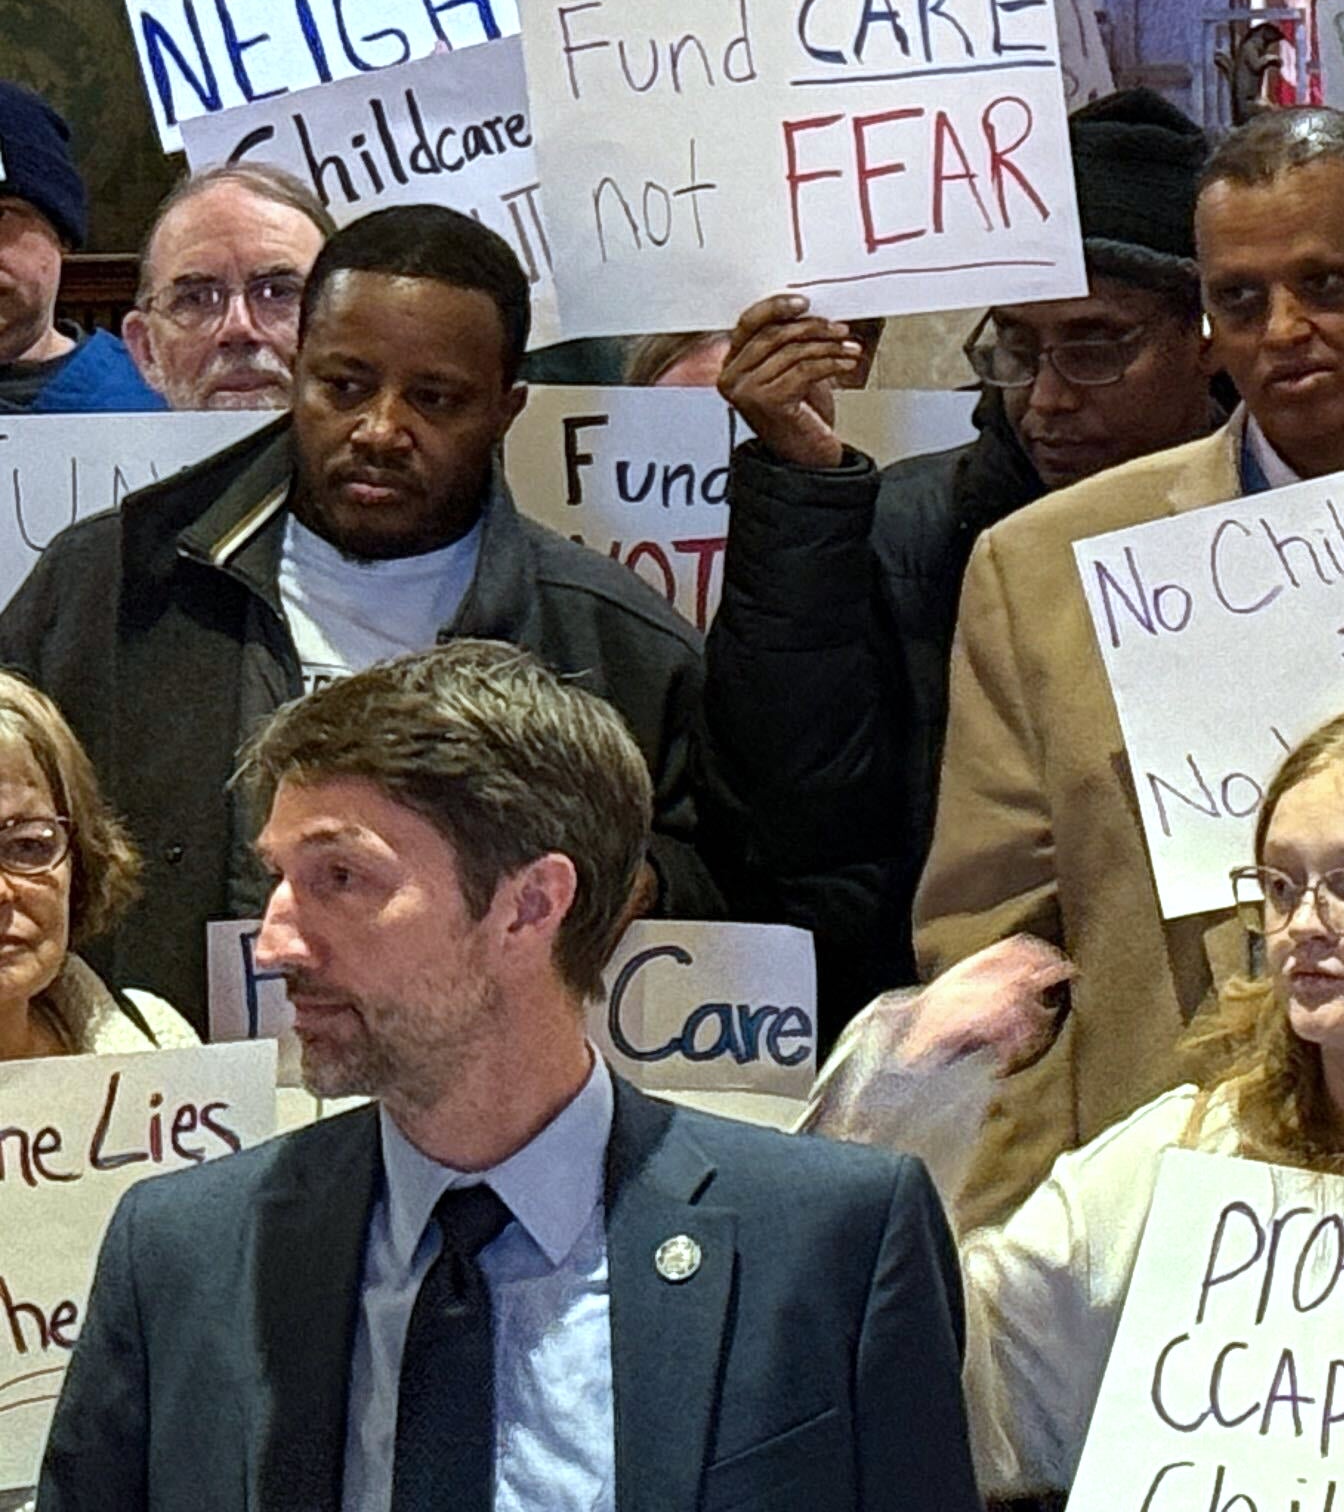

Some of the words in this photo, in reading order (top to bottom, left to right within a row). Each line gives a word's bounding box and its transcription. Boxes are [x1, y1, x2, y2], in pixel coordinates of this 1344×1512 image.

[591, 137, 717, 263] not
[781, 95, 1051, 263] FEAR
[561, 406, 736, 509] Fund
[1093, 545, 1193, 650] No
[1146, 752, 1264, 838] No
[607, 945, 813, 1066] Care
[90, 1070, 242, 1170] Lies
